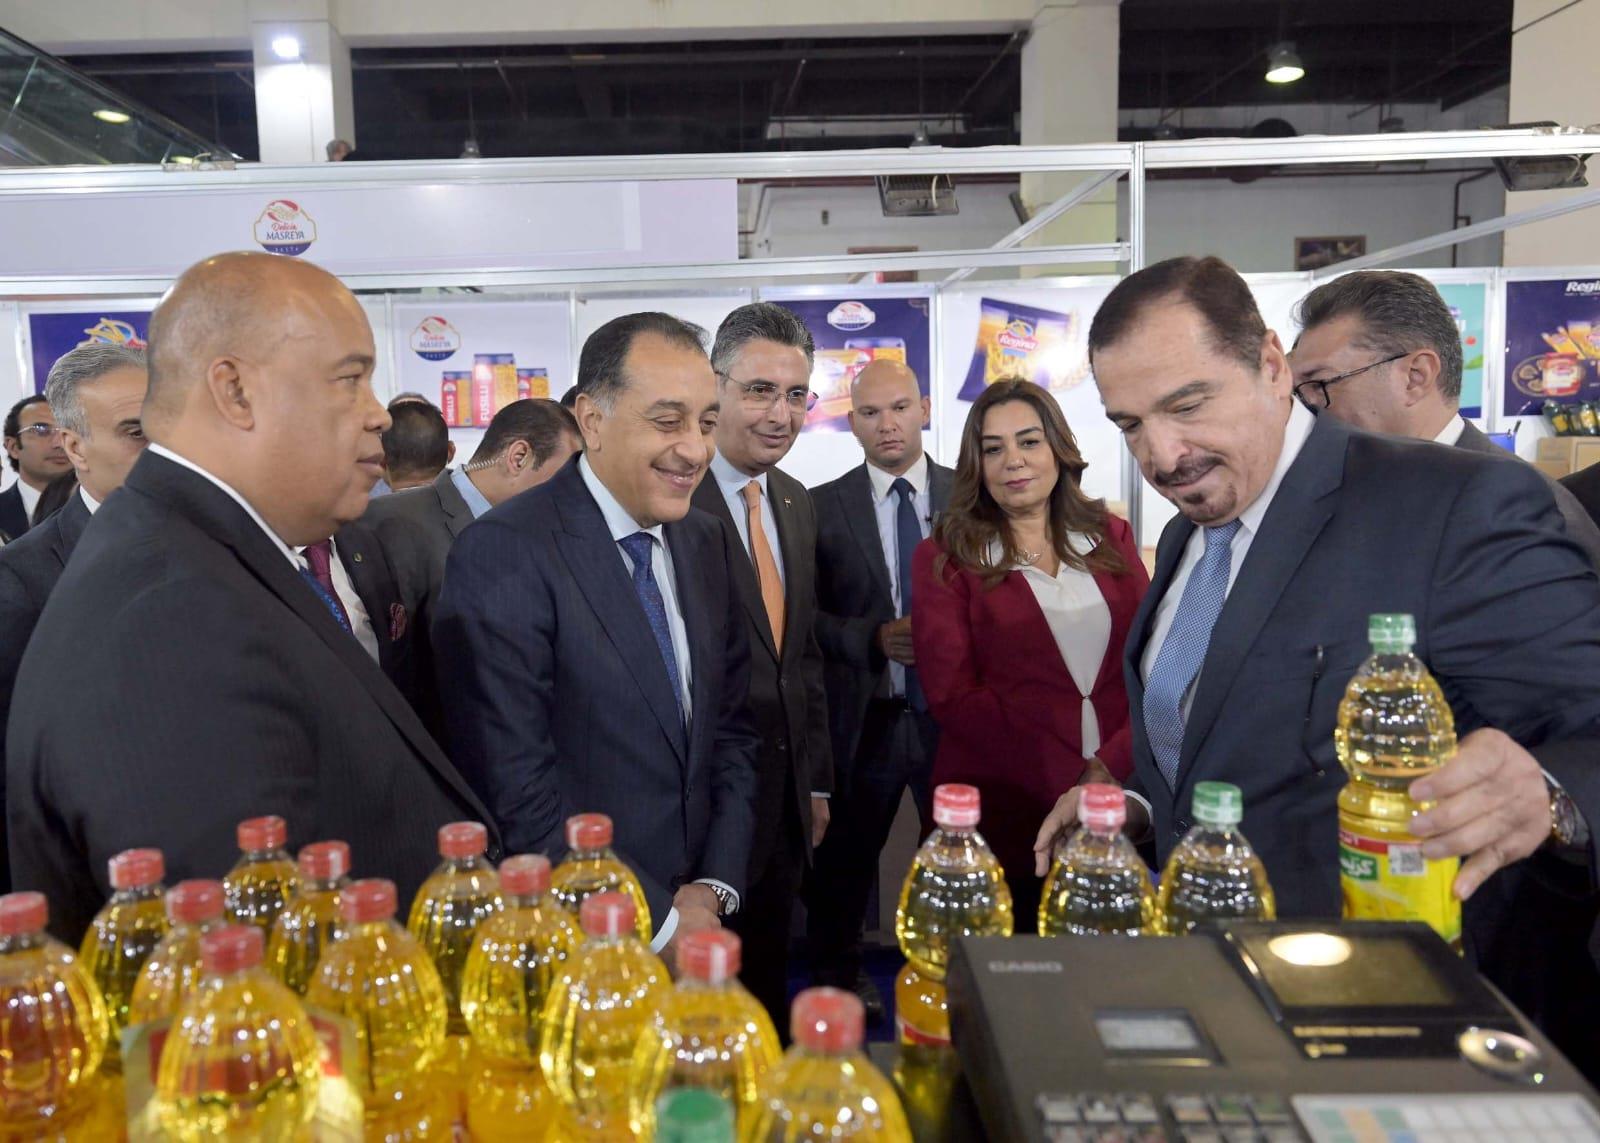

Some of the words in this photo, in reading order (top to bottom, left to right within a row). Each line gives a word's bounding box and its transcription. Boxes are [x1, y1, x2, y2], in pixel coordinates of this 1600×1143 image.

[266, 231, 304, 240] MASREYA
[1566, 280, 1600, 293] Regi
[988, 960, 1063, 973] CASIO
